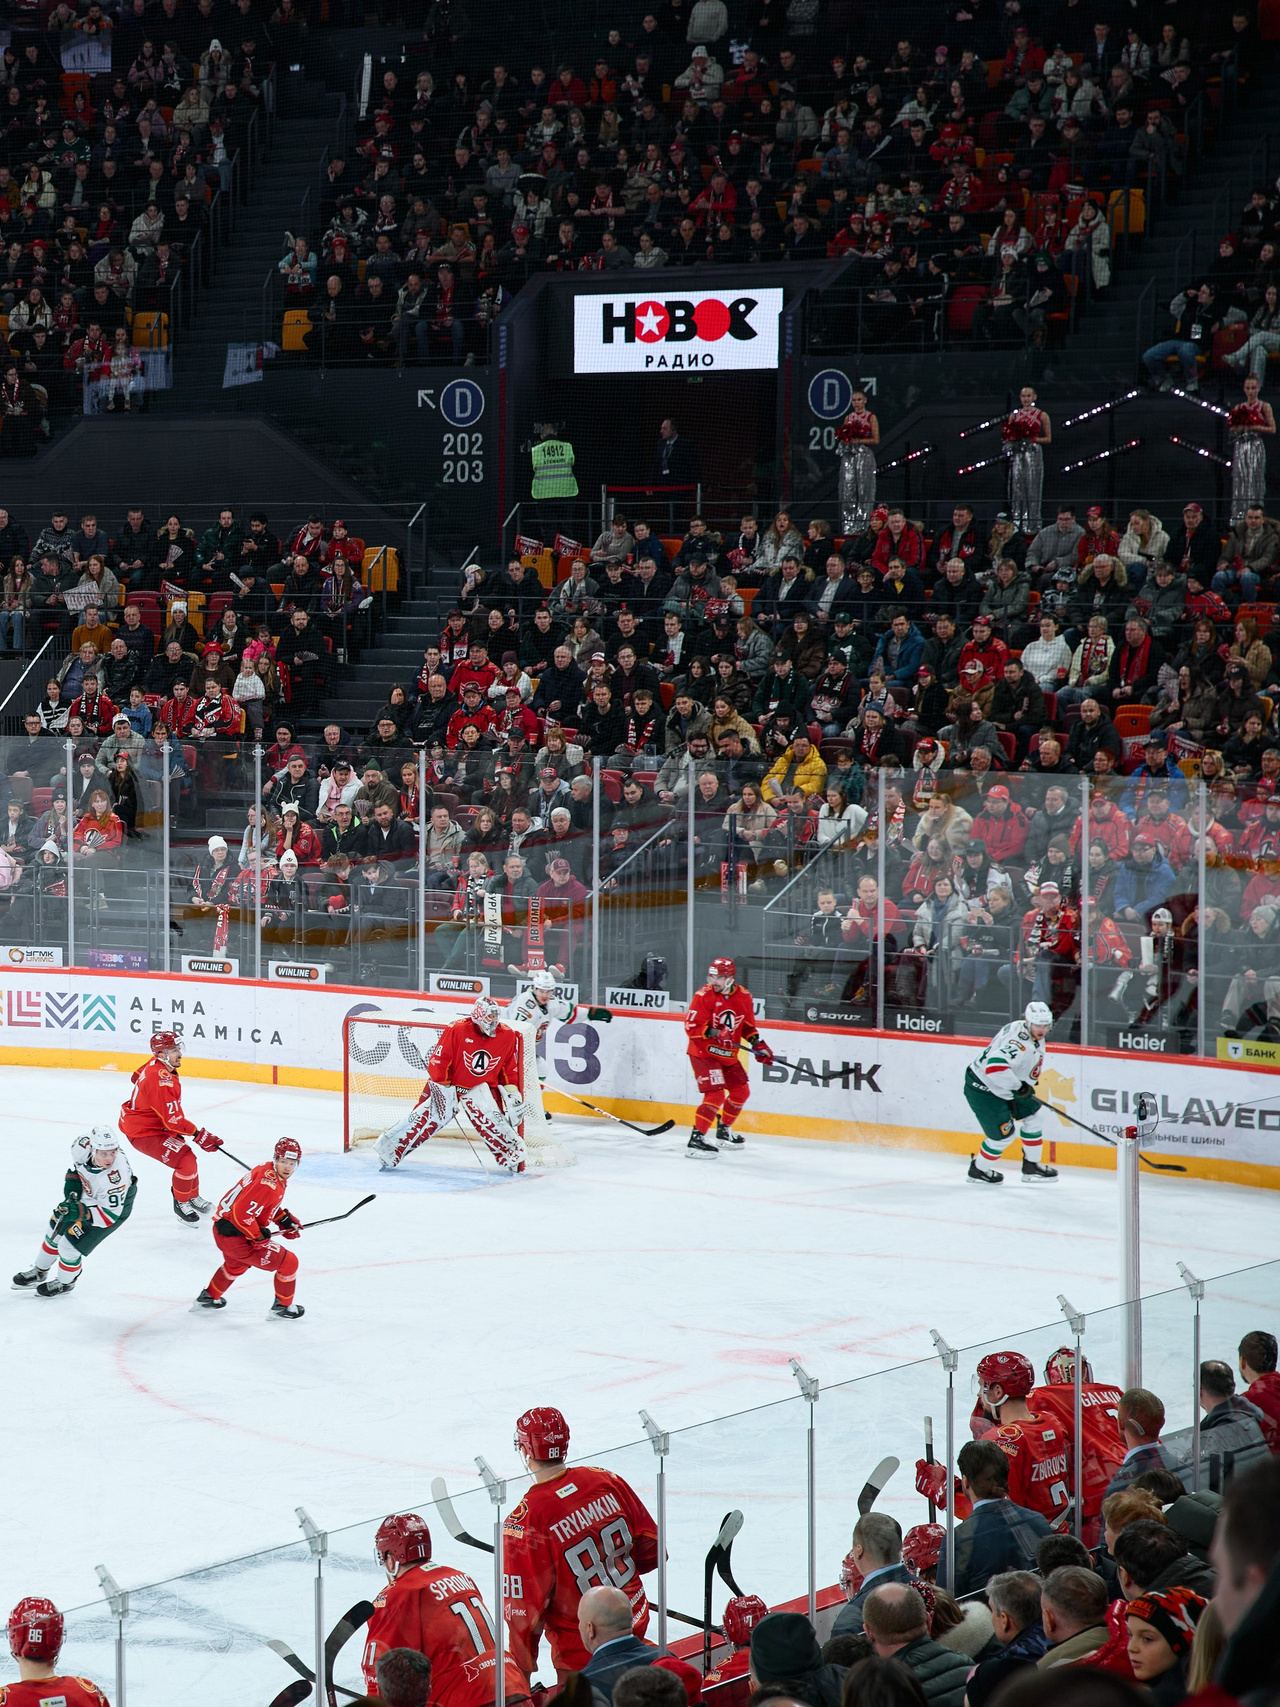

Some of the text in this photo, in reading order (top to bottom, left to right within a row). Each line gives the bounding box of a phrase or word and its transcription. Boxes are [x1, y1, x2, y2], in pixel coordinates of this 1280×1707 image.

[645, 353, 715, 369] РАДИО
[454, 388, 473, 417] D
[823, 379, 839, 410] D
[442, 433, 484, 456] 202
[809, 426, 836, 450] 20
[543, 445, 564, 457] 14912
[442, 460, 484, 483] 203
[191, 961, 223, 972] WINLINE
[278, 967, 310, 978] WINLINE
[439, 980, 474, 991] WINLINE
[130, 997, 205, 1015] ALMA
[610, 991, 665, 1008] KHL.RU
[819, 1012, 861, 1021] SOYUZ
[897, 1014, 942, 1033] Haier
[130, 1019, 283, 1046] CERAMICA
[1119, 1032, 1166, 1051] Haier
[1000, 1045, 1018, 1059] 24
[1246, 1048, 1276, 1059] БАНК
[762, 1056, 882, 1092] БАНК
[1191, 1135, 1225, 1146] ШИНЫ
[246, 1201, 265, 1217] 24
[549, 1447, 560, 1458] 88
[549, 1493, 621, 1543] TRYAMKIN
[564, 1516, 636, 1597] 88
[429, 1573, 476, 1601] SPRONG
[511, 1609, 527, 1617] РМК
[449, 1596, 497, 1656] 11
[28, 1629, 43, 1643] 86
